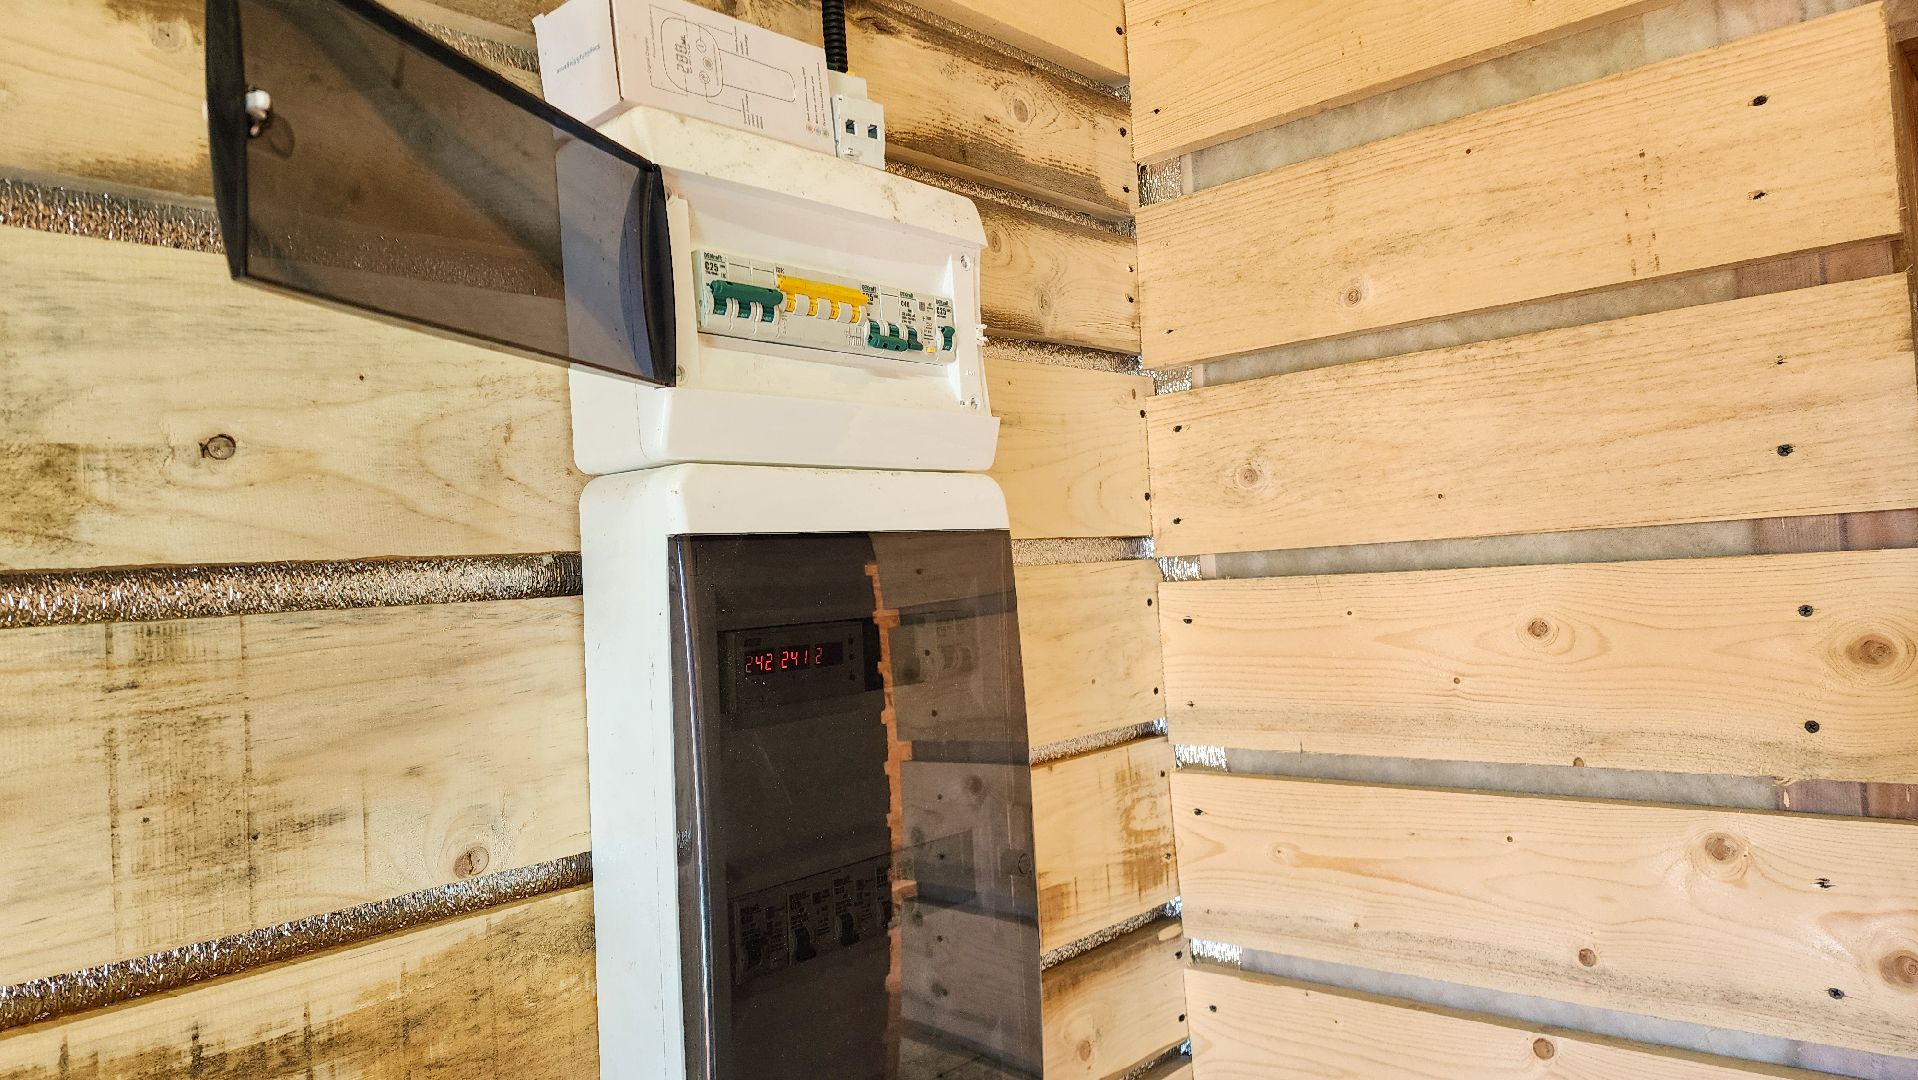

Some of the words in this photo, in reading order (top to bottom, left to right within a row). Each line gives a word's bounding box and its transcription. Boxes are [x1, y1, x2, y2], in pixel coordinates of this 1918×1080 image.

[704, 261, 719, 272] C25
[745, 652, 773, 674] 242
[780, 649, 808, 669] 241
